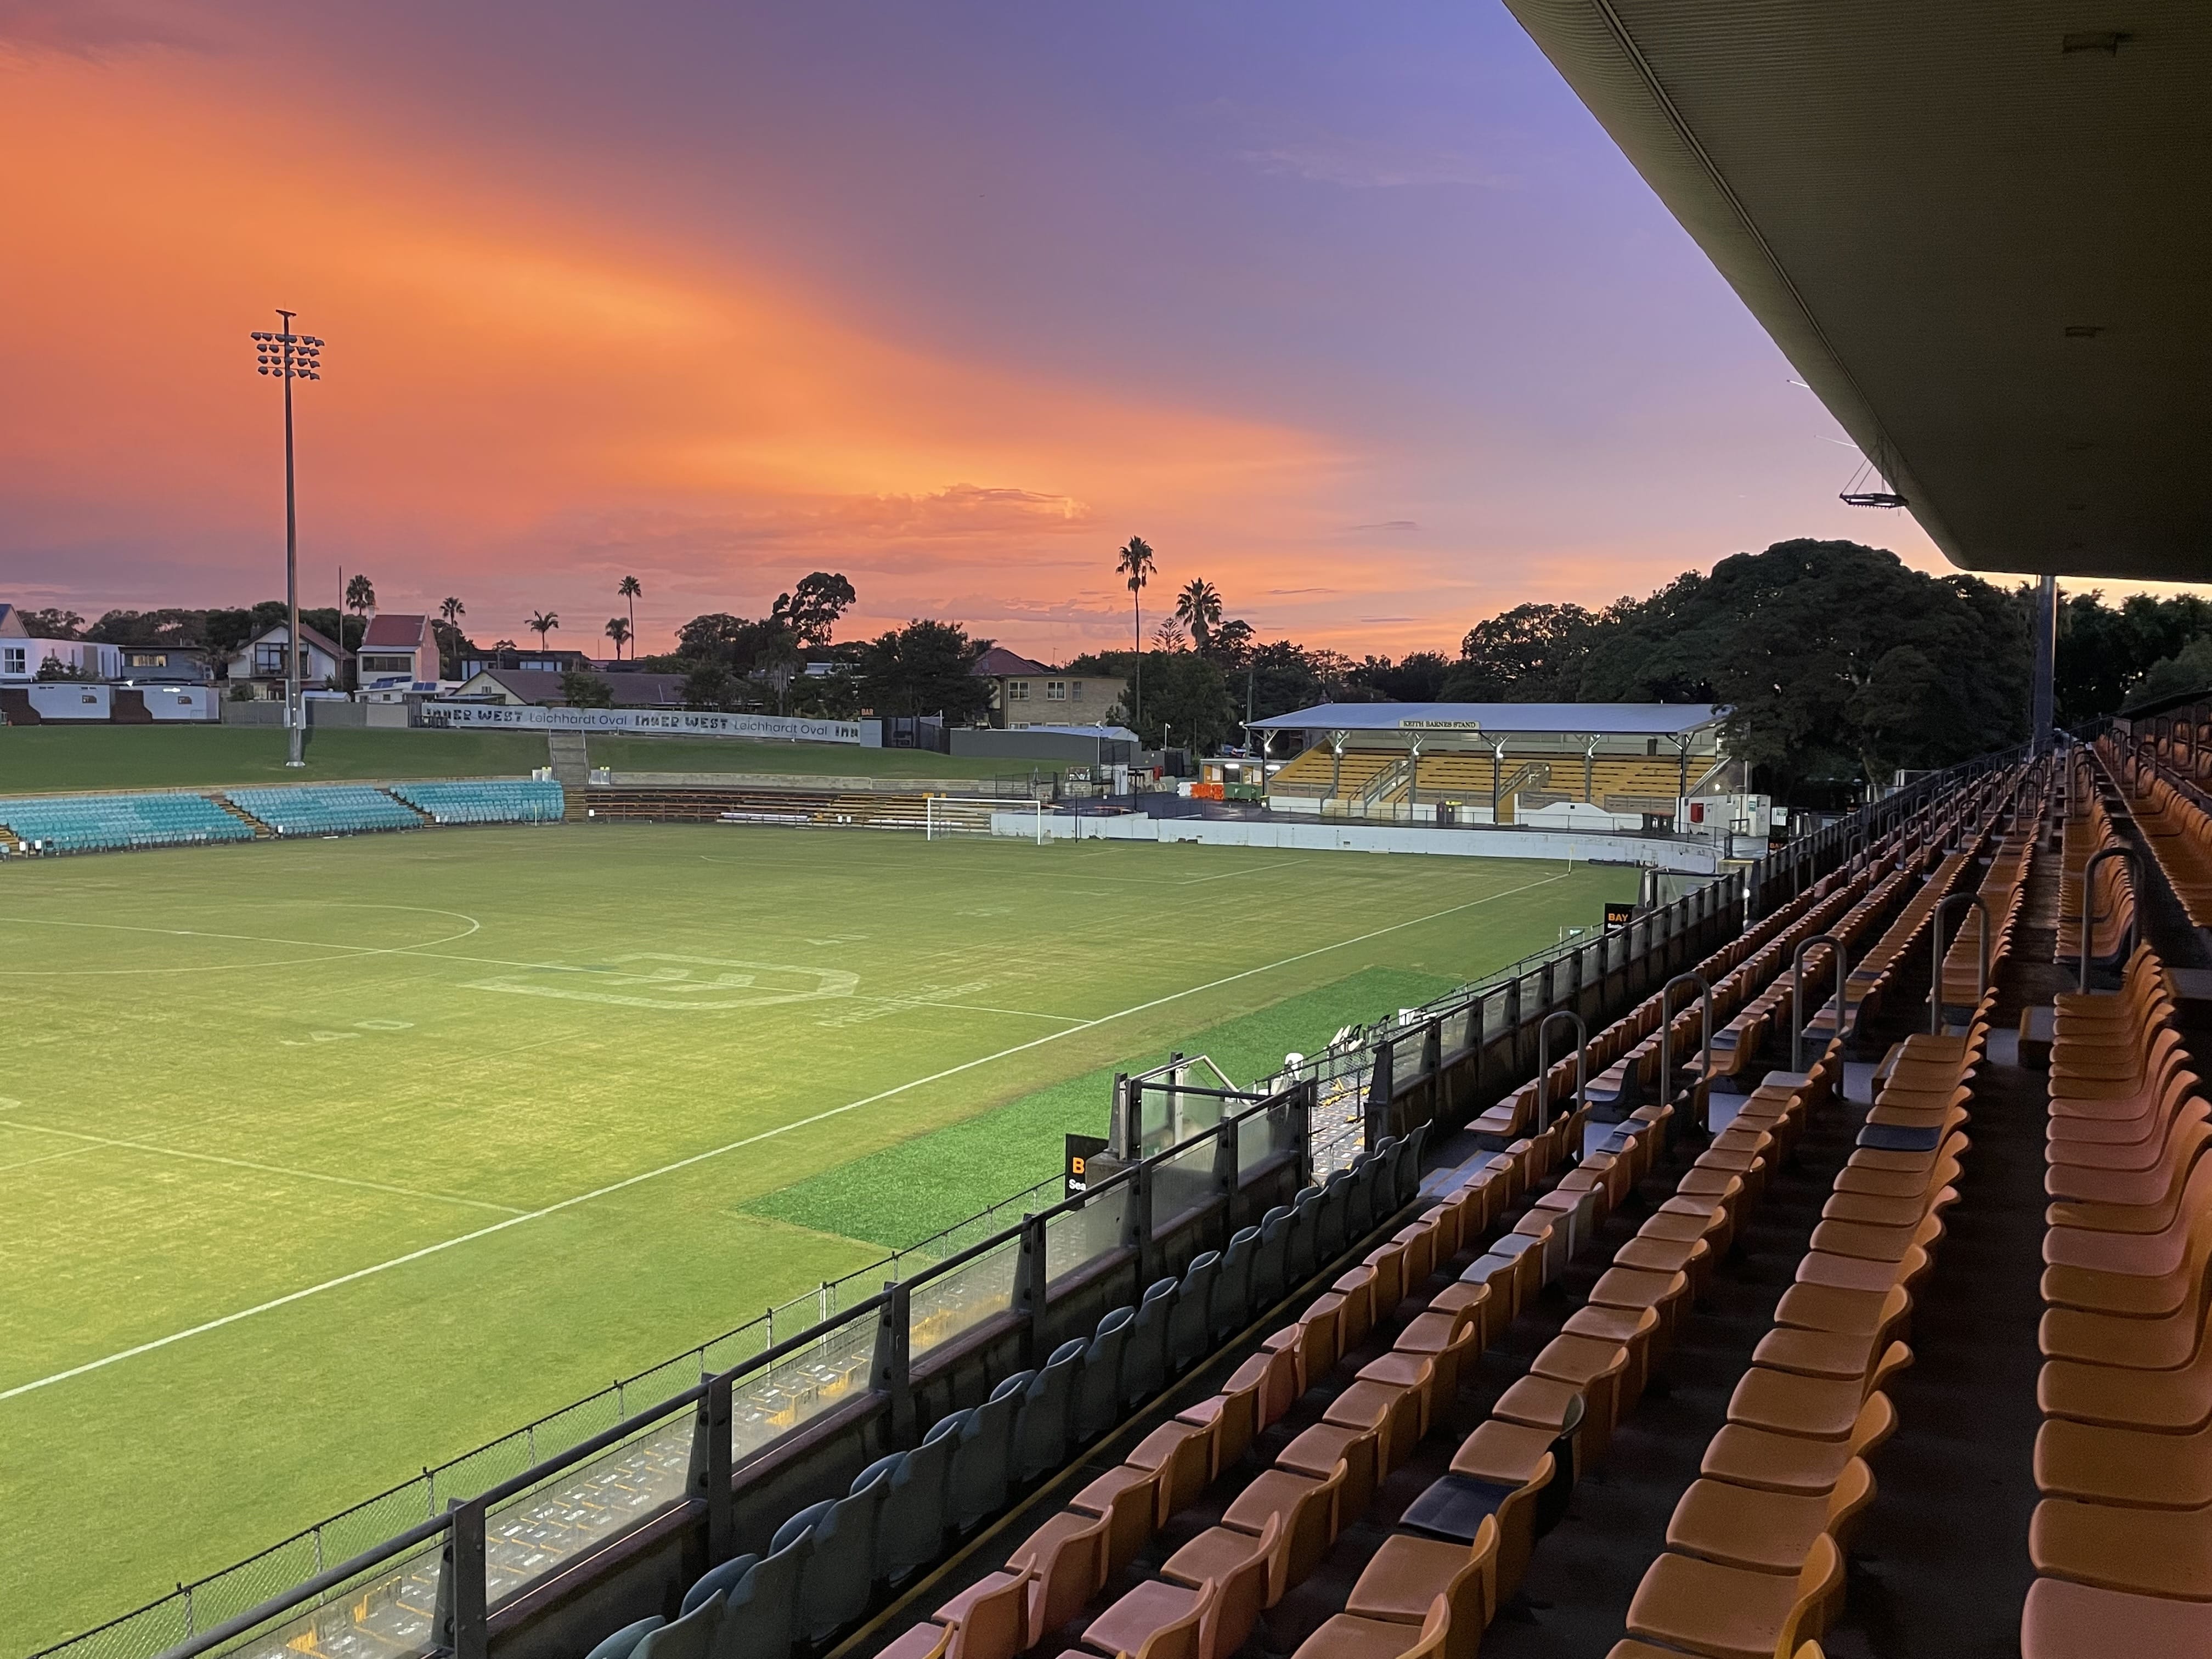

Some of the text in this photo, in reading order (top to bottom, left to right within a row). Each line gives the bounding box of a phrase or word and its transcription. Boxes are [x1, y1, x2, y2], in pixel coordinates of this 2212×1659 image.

[478, 710, 523, 722] WEST
[530, 713, 596, 725] Leichhardt
[599, 715, 627, 725] Oval
[685, 717, 728, 729] WEST
[734, 719, 798, 734] Leichhardt
[800, 725, 827, 736] Oval
[1608, 913, 1628, 922] BAY
